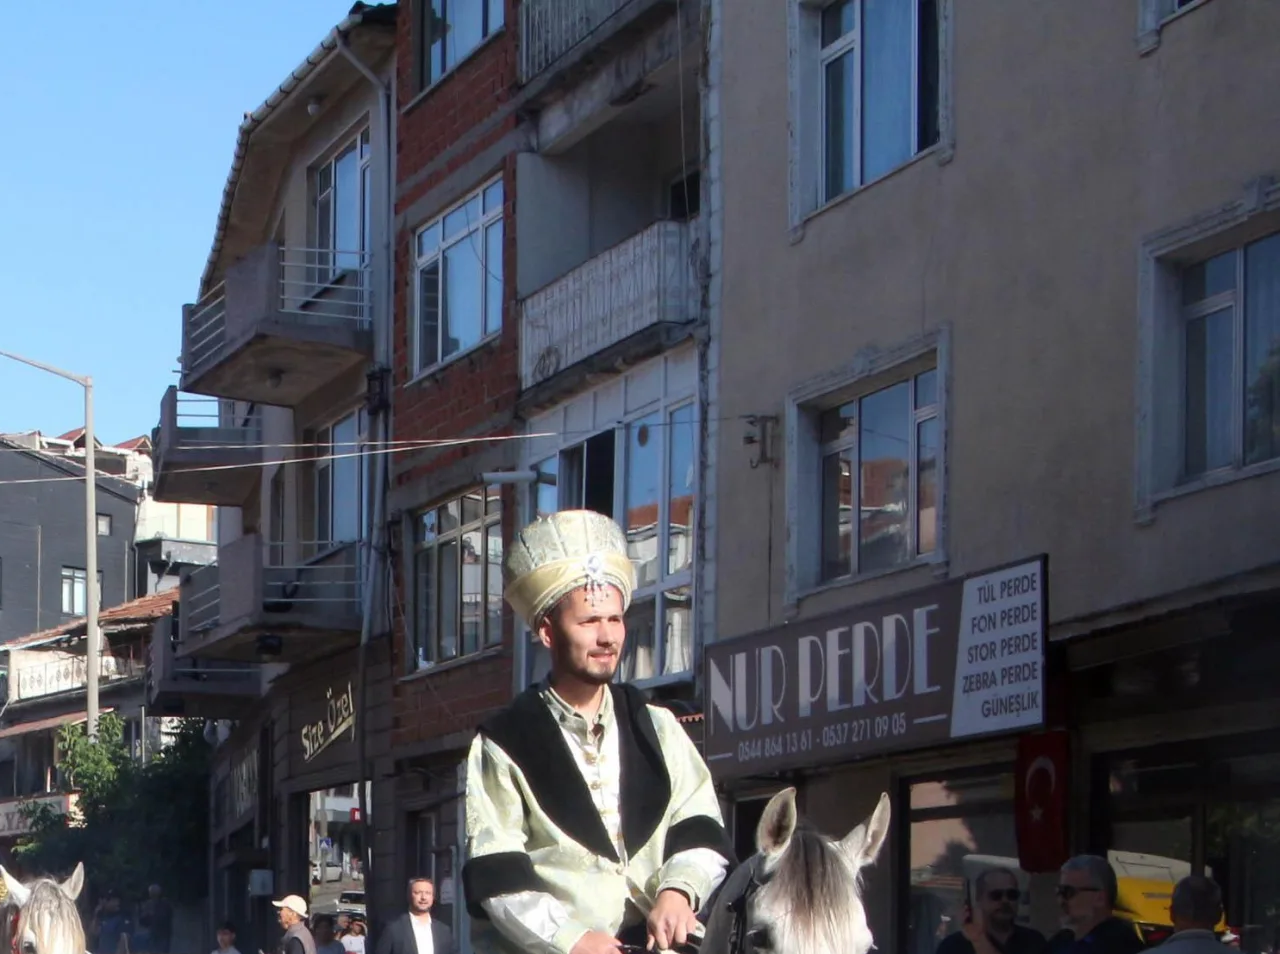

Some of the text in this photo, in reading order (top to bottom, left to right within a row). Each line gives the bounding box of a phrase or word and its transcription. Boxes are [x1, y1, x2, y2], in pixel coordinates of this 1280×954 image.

[977, 572, 1037, 604] TÜL PERDE
[972, 602, 1037, 635] FON PERDE
[967, 631, 1038, 664] STOR PERDE
[710, 604, 941, 735] NUR PERDE
[962, 661, 1038, 694] ZEBRA PERDE
[981, 685, 1039, 718] GÜNEŞLİK
[301, 681, 353, 760] Size Özel
[738, 738, 762, 762] 0544
[786, 731, 798, 753] 13
[822, 722, 848, 747] 0537
[852, 718, 870, 742] 271
[874, 715, 889, 738] 09
[892, 712, 906, 736] 05
